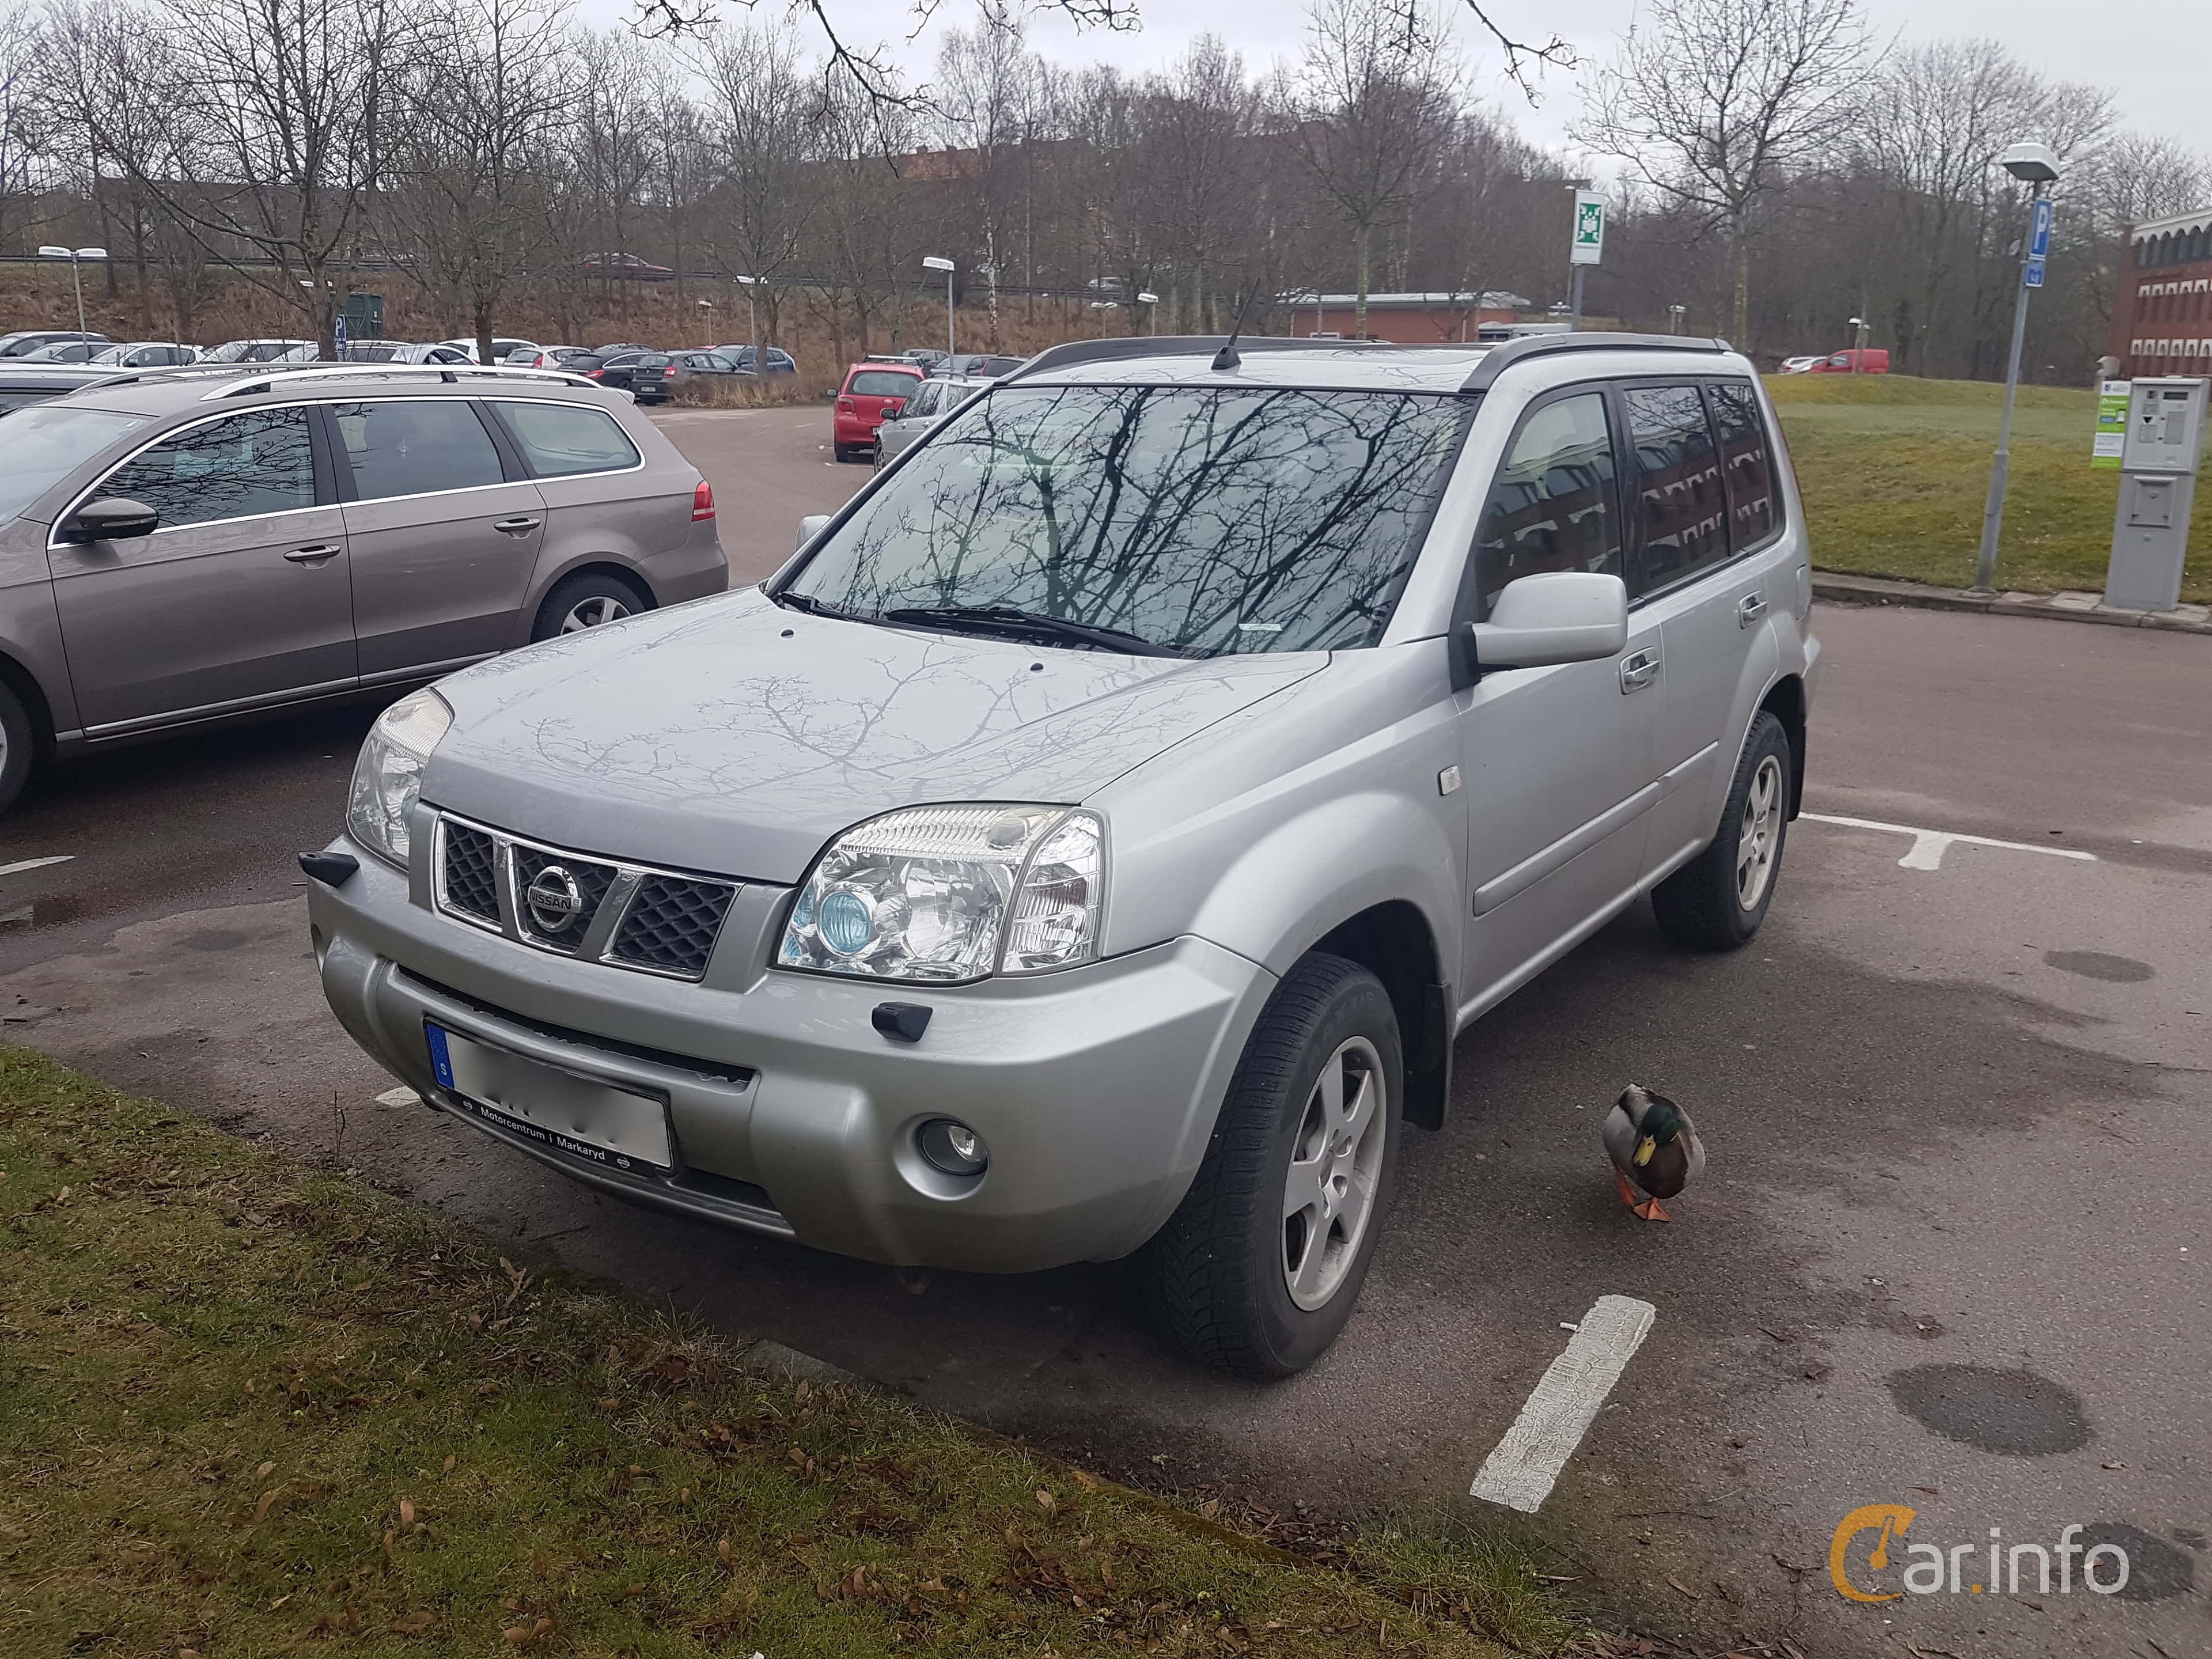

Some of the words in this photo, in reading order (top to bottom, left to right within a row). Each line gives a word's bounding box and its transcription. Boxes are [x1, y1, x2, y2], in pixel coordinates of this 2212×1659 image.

[2034, 205, 2048, 249] P
[336, 317, 342, 336] P
[531, 893, 571, 910] NISSAN
[440, 1062, 447, 1076] S
[480, 1106, 545, 1141] Motorcentrum
[556, 1136, 605, 1161] Markaryd
